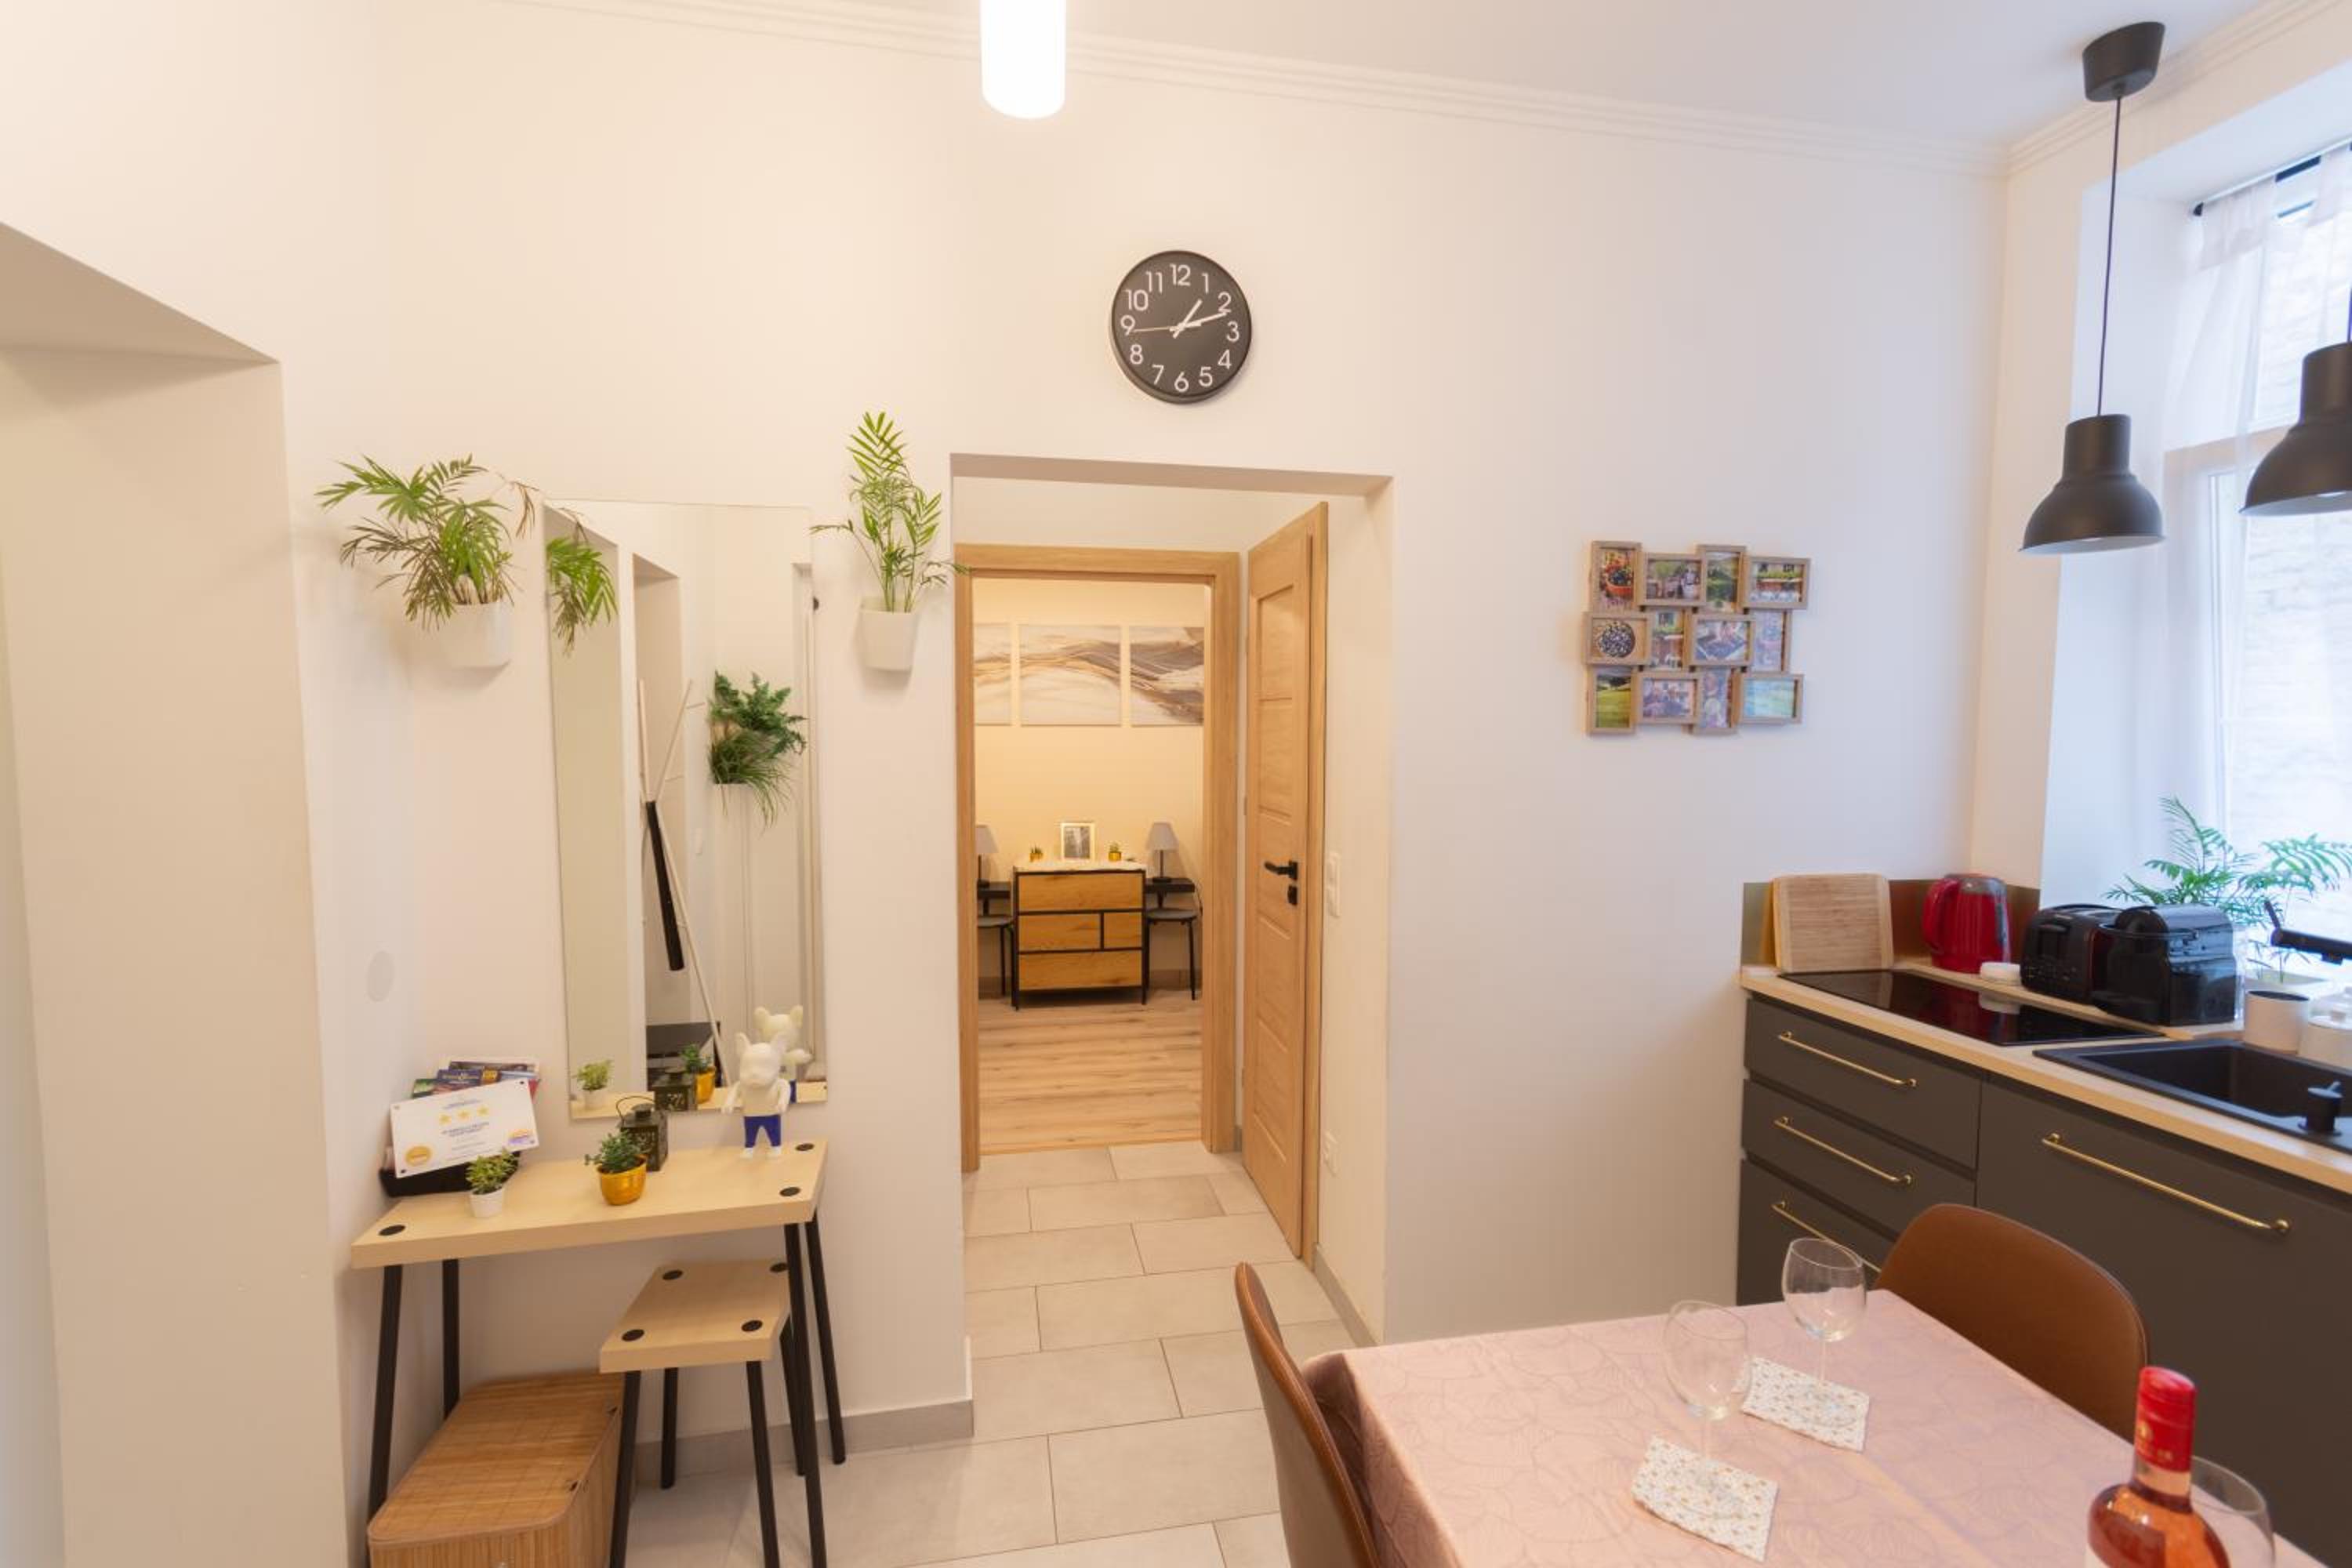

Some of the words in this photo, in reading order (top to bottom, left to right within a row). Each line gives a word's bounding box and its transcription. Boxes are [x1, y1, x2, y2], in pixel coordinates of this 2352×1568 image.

[1145, 271, 1163, 294] 11
[1170, 263, 1191, 286] 12
[1202, 273, 1209, 294] 1
[1125, 289, 1149, 311] 10
[1218, 292, 1232, 313] 2
[1120, 315, 1136, 336] 9
[1226, 321, 1240, 342] 3
[1130, 344, 1144, 365] 8
[1218, 350, 1232, 369] 4
[1152, 365, 1164, 385] 7
[1174, 372, 1189, 392] 6
[1199, 367, 1213, 387] 5
